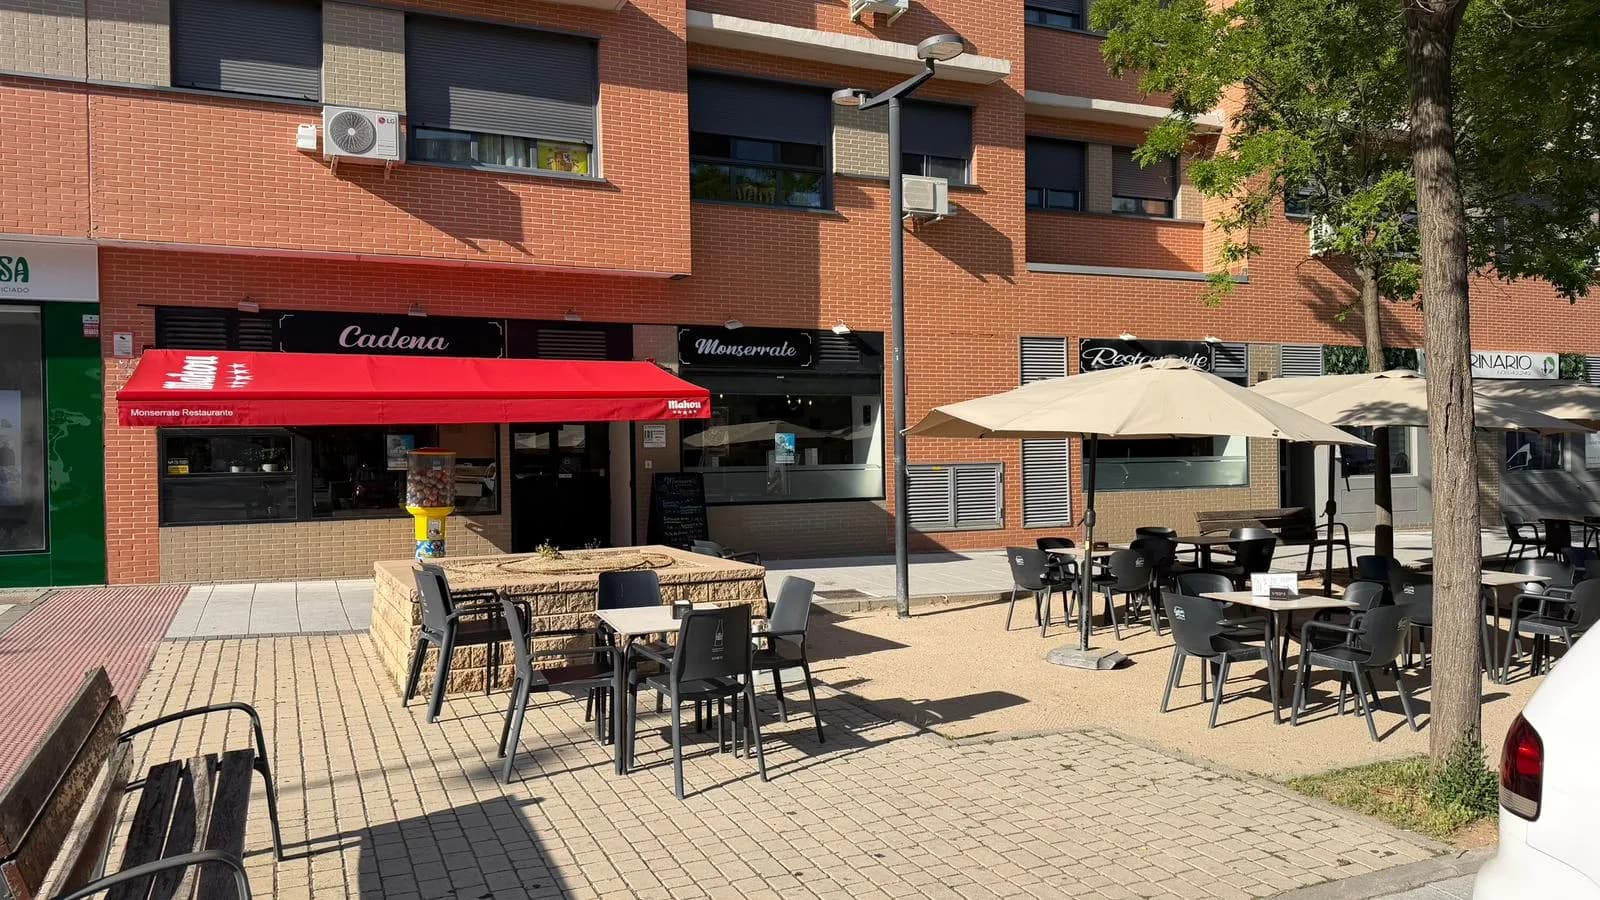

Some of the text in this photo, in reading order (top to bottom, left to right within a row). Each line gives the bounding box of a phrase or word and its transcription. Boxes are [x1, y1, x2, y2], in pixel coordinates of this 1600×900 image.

[0, 256, 29, 282] SA
[339, 325, 449, 350] Cadena
[695, 338, 797, 357] Monserrate
[1470, 353, 1532, 370] RINARIO
[130, 408, 234, 417] Monserrate Restaurante
[668, 400, 701, 409] Mahou
